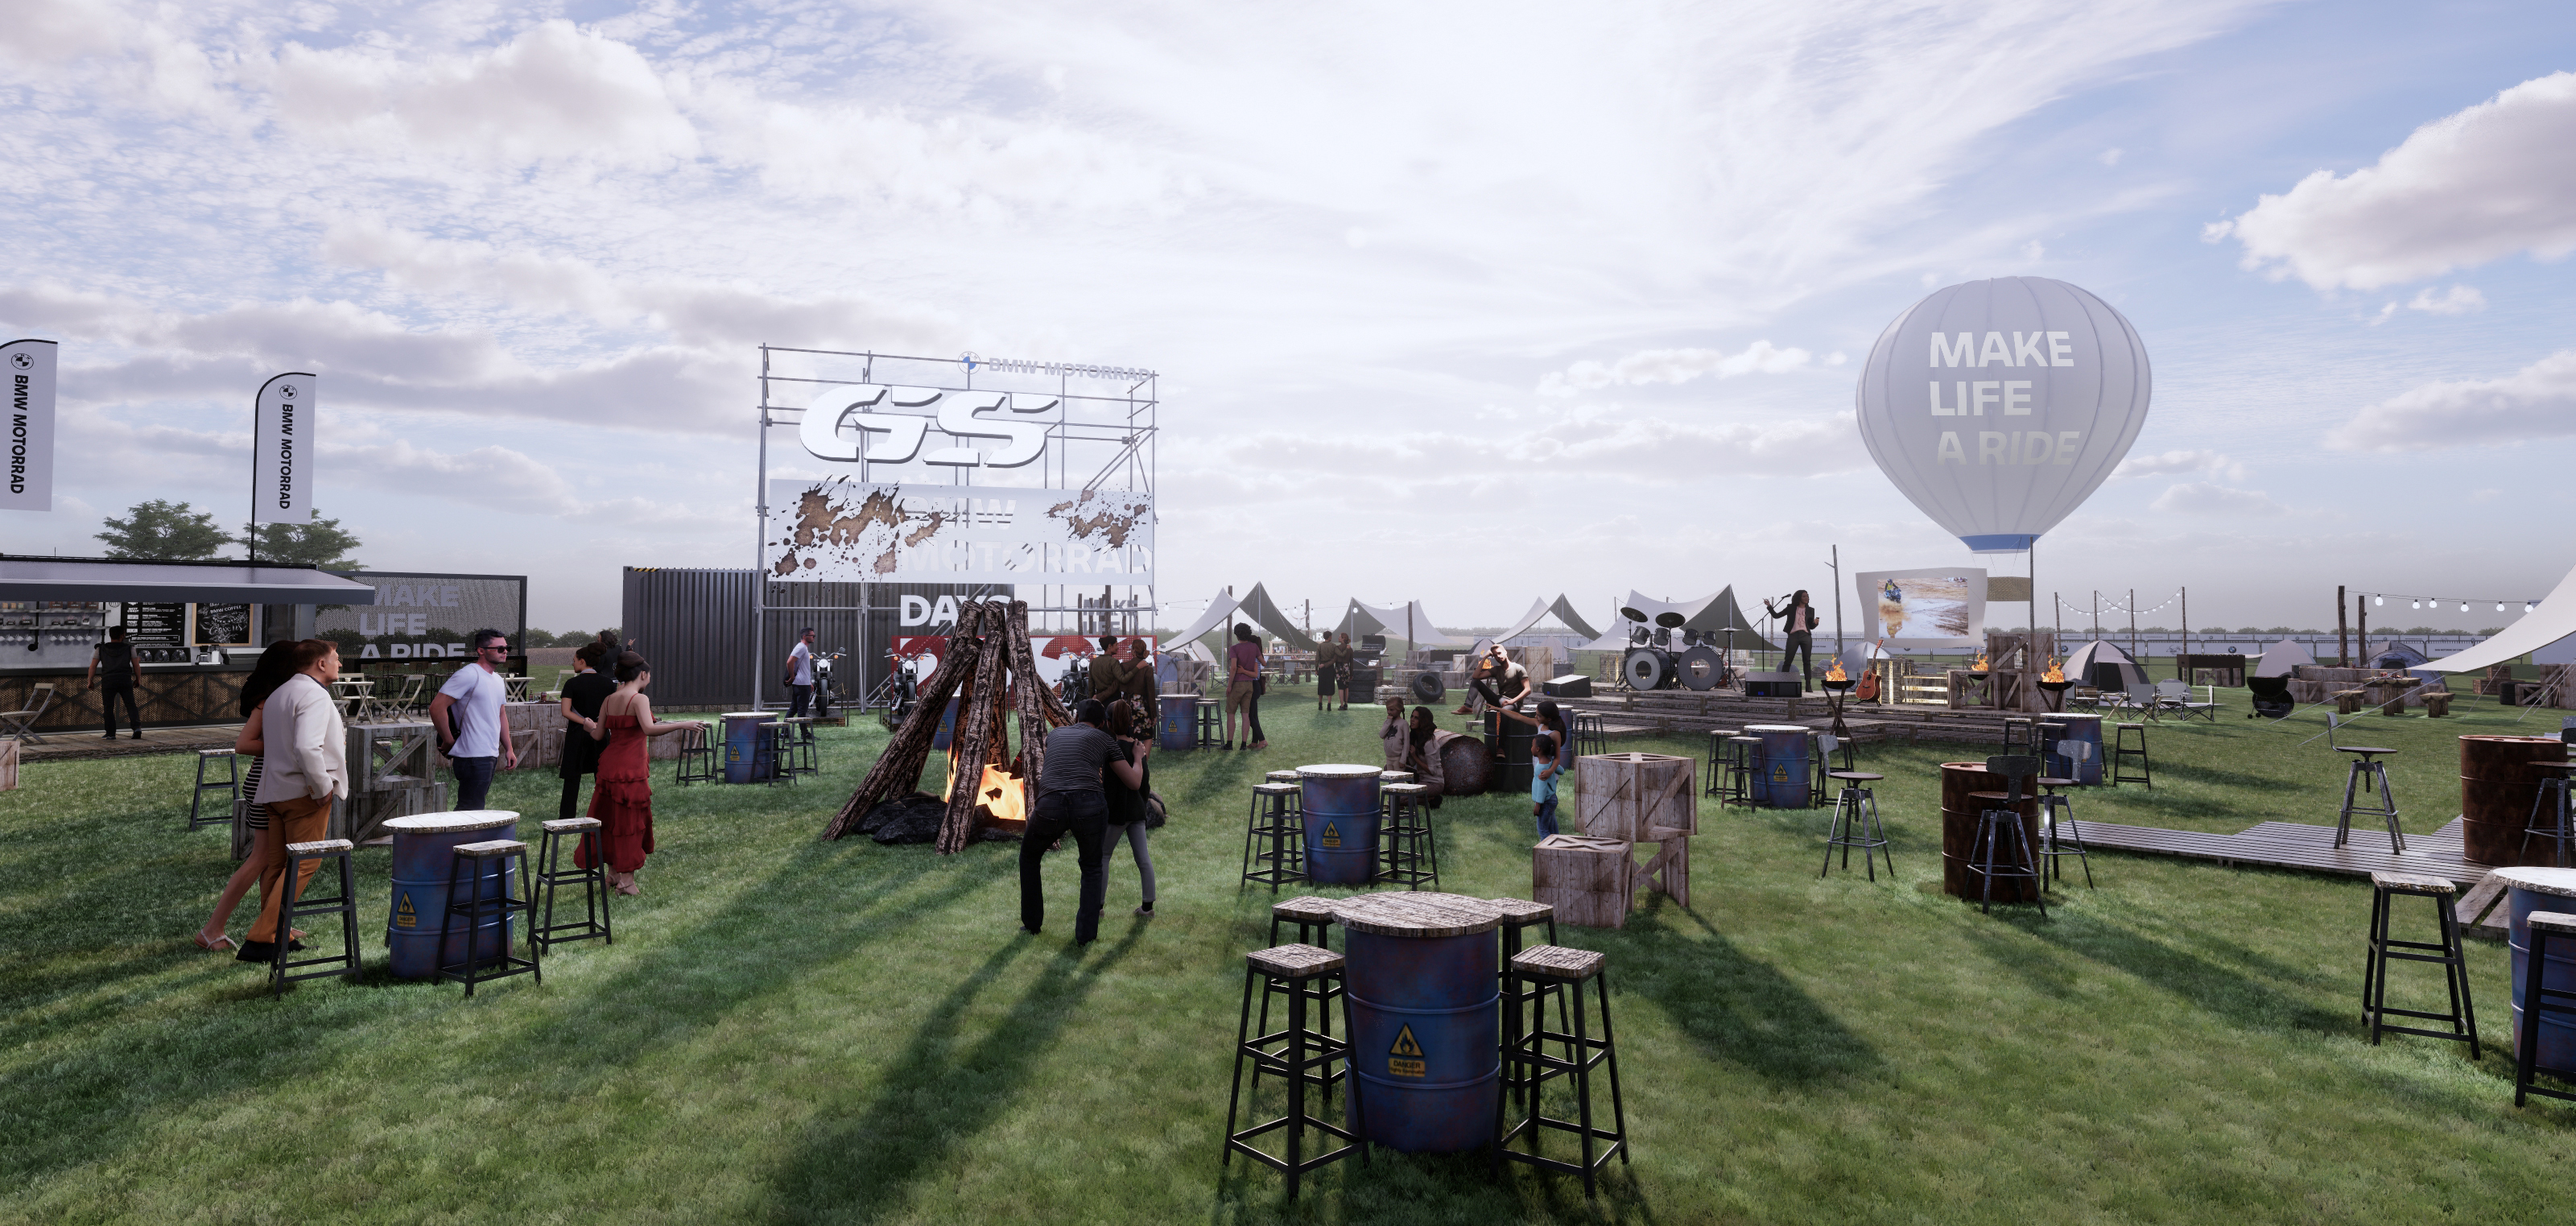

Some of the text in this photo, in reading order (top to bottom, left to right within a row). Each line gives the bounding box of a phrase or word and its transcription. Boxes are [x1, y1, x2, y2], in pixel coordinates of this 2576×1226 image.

[1930, 331, 2074, 367] MAKE
[989, 357, 1152, 382] BMW MOTORRAD
[1930, 380, 2032, 415] LIFE
[10, 374, 28, 493] BMW MOTORRAD
[799, 383, 1059, 469] GS
[279, 404, 294, 509] BMW MOTORRAD
[1937, 431, 2081, 465] A RIDE
[902, 496, 1017, 530] BMW
[901, 539, 1153, 574] MOTORRAD
[360, 613, 427, 635] LIFE
[360, 643, 466, 658] A RIDE
[1393, 1059, 1421, 1069] DANGER
